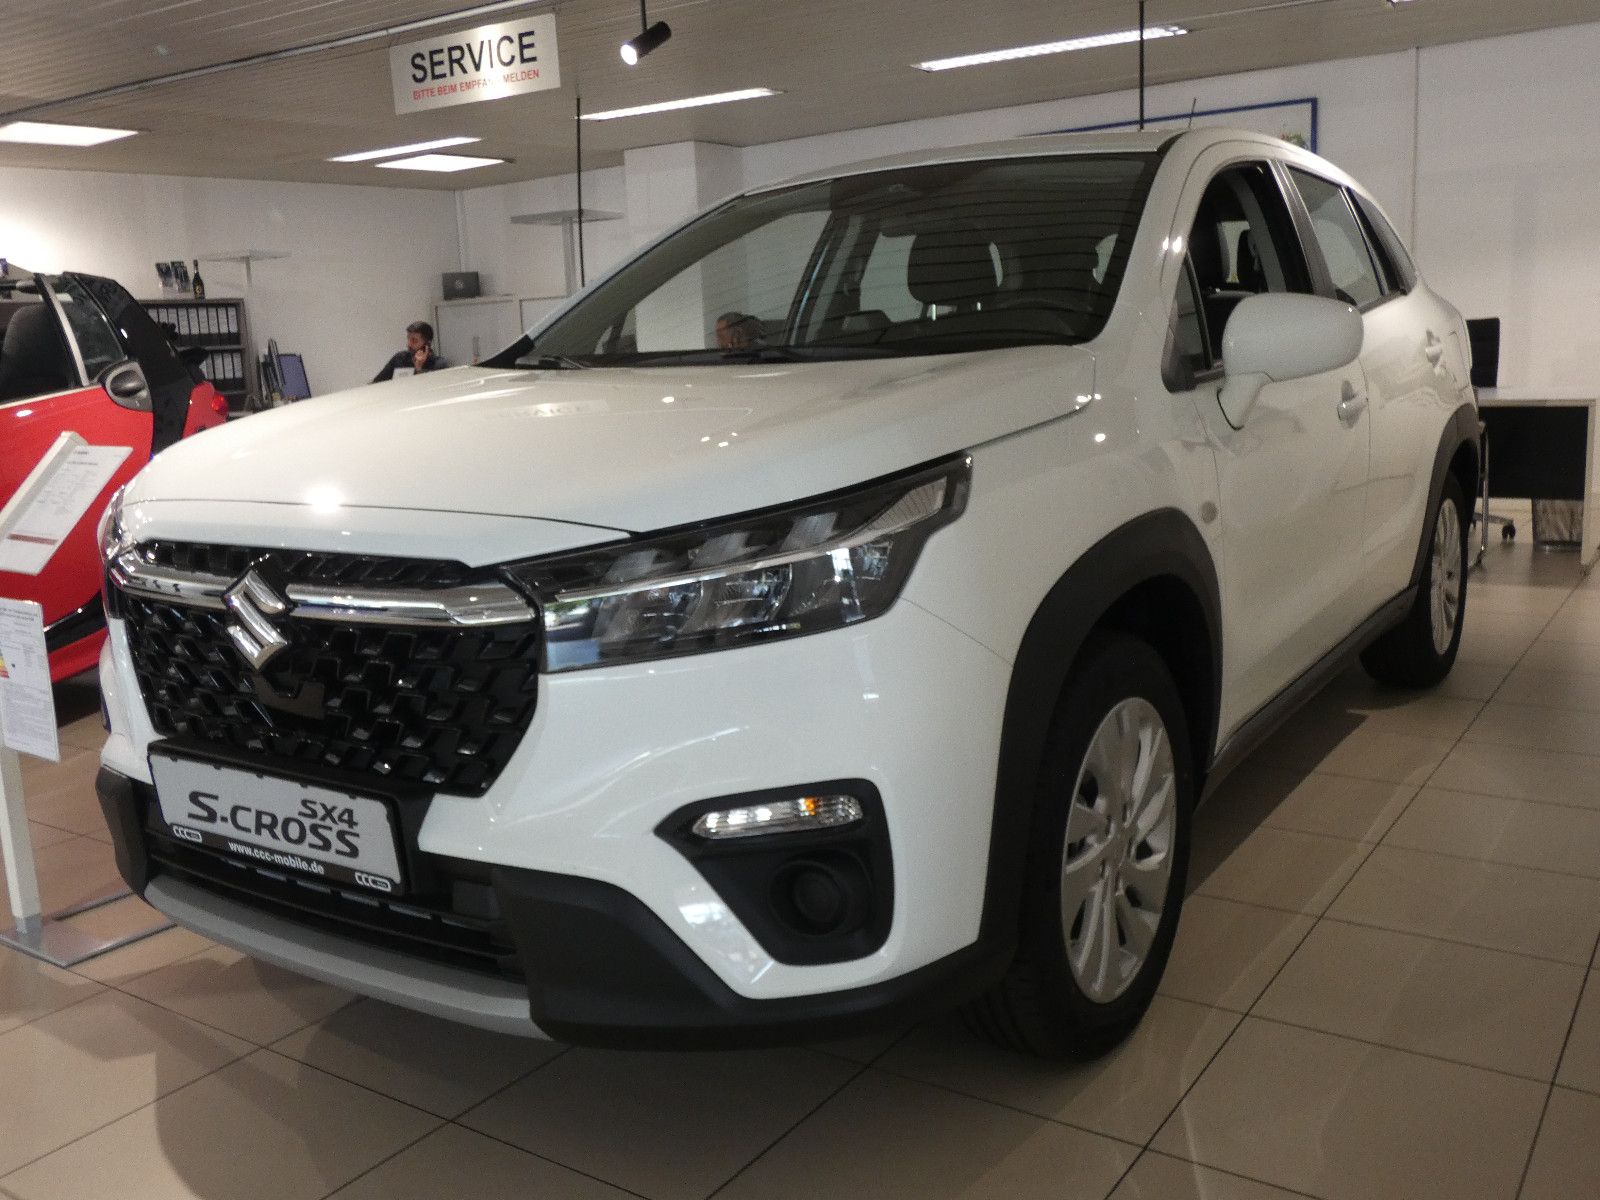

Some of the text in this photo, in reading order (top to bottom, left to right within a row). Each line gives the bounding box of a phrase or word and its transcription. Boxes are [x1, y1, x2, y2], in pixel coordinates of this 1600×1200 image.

[411, 31, 537, 83] SERVICE
[412, 88, 436, 100] BITTE
[437, 84, 457, 96] BEIM
[503, 69, 540, 83] MELDEN
[298, 799, 358, 829] SX4
[228, 841, 325, 875] www.ccc-mobile.de
